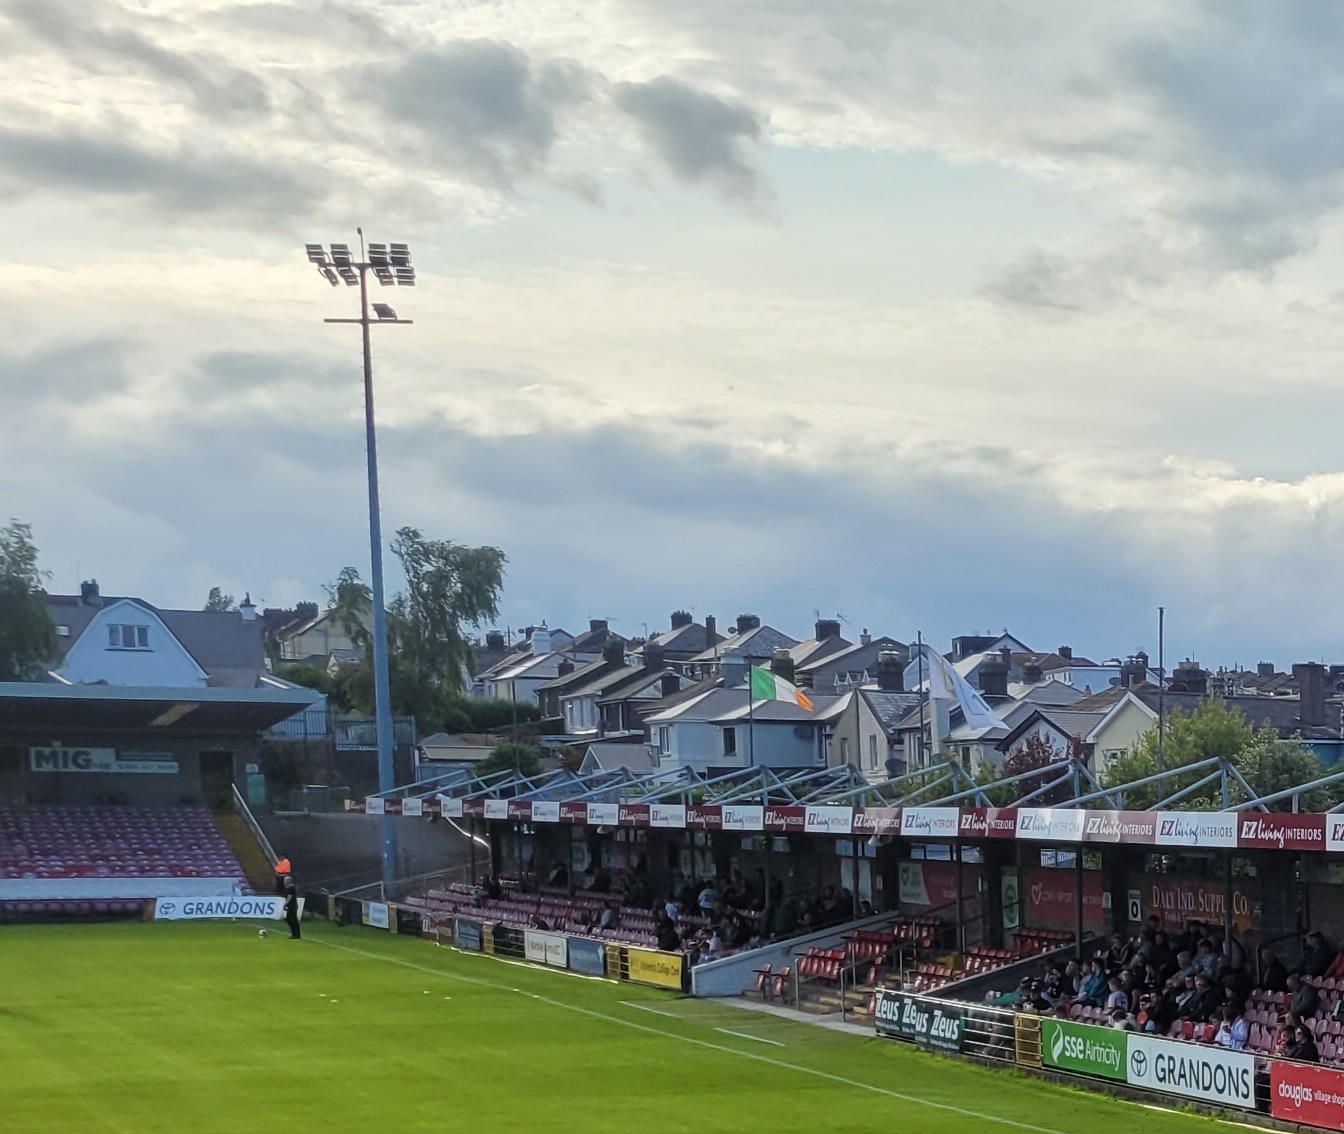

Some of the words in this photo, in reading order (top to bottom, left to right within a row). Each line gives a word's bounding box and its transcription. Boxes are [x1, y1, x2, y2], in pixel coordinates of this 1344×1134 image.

[34, 750, 91, 769] MIG
[905, 815, 915, 828] EZ
[960, 814, 973, 829] EZ
[972, 813, 989, 836] living
[1020, 815, 1033, 830] EZ
[1086, 818, 1100, 834] EZ
[1099, 816, 1122, 842] living
[1122, 824, 1153, 835] INTERIORS
[1160, 820, 1175, 836] EZ
[1174, 818, 1199, 844] living
[1200, 826, 1233, 838] INTERIORS
[1241, 821, 1257, 839] EZ
[1256, 822, 1285, 848] living
[1285, 828, 1322, 841] INTERIORS
[183, 902, 275, 915] GRANDONS
[1198, 888, 1226, 913] SUPPL
[874, 992, 900, 1022] Zeus
[930, 1009, 960, 1040] Zeus
[1064, 1036, 1084, 1059] sse
[1085, 1039, 1121, 1071] Airtricity
[1155, 1053, 1250, 1100] GRANDONS
[1278, 1080, 1313, 1108] douglas
[1314, 1090, 1332, 1105] village
